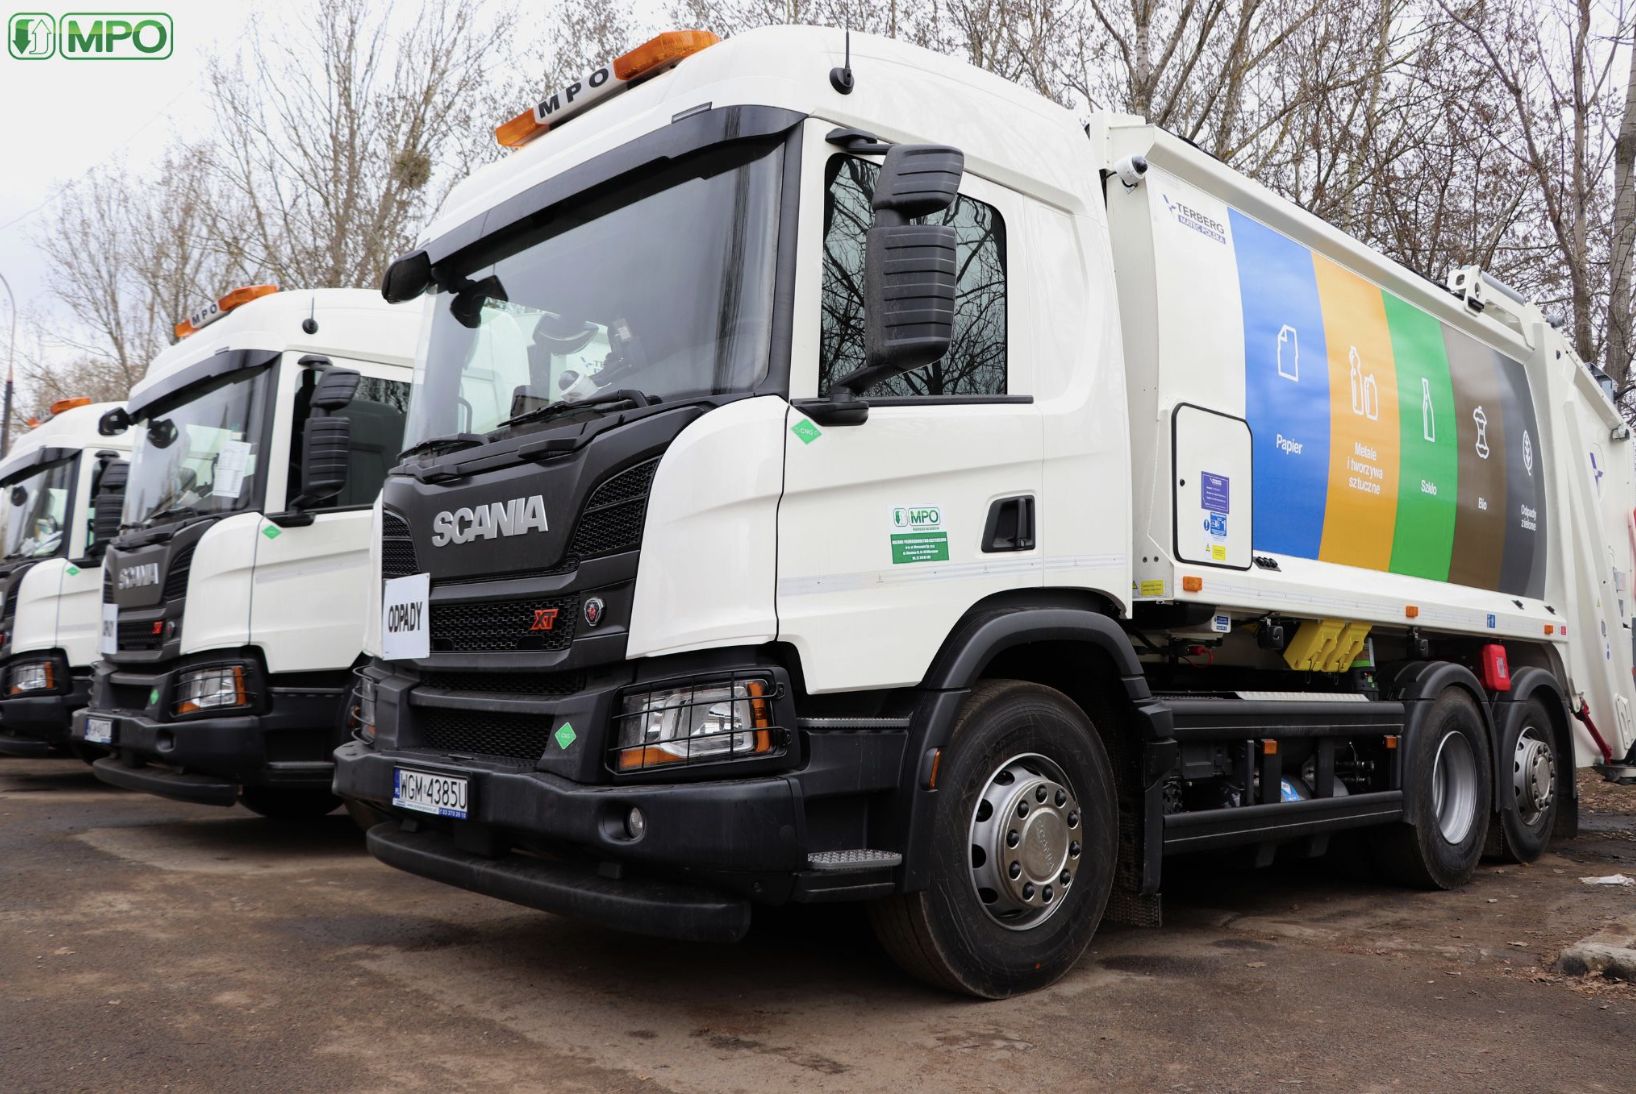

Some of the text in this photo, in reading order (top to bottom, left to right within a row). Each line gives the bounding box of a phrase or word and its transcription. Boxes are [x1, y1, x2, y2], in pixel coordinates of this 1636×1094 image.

[538, 68, 609, 119] MPO
[1176, 202, 1225, 235] TERBERG
[192, 303, 217, 326] MPO
[1276, 433, 1303, 455] Papier
[1354, 441, 1377, 461] Metale
[1351, 458, 1383, 480] tworzywa
[1348, 476, 1381, 495] sztuczne
[1478, 497, 1488, 511] Bio
[1520, 504, 1537, 521] Odpady
[431, 494, 549, 548] SCANIA
[910, 509, 939, 524] MPO
[388, 601, 423, 632] ODPADY
[530, 608, 559, 631] XT
